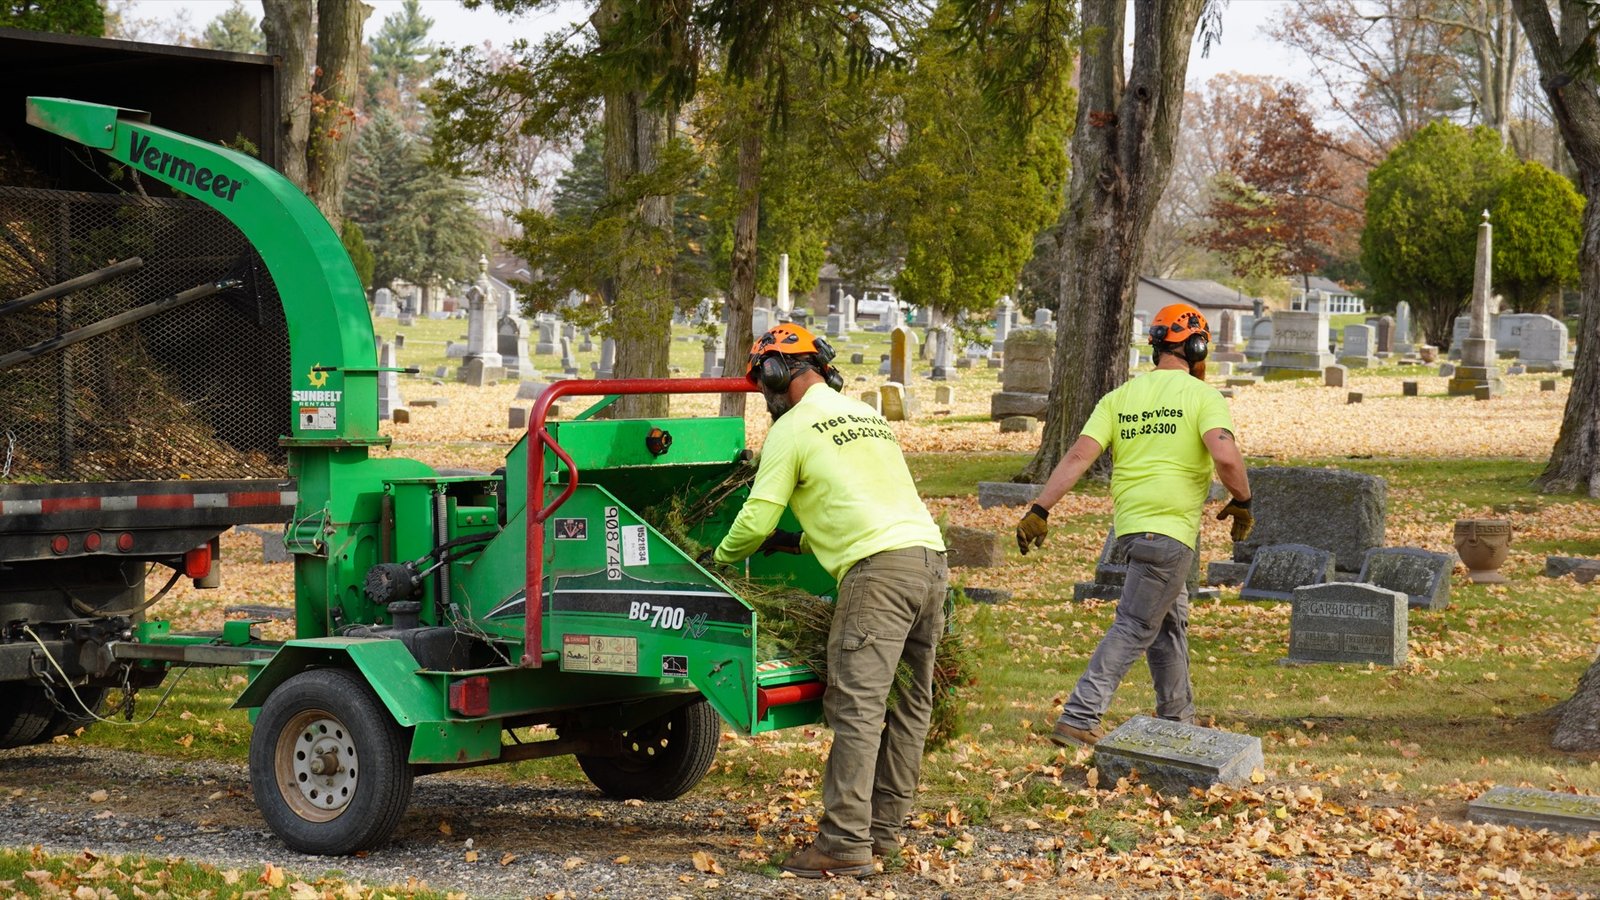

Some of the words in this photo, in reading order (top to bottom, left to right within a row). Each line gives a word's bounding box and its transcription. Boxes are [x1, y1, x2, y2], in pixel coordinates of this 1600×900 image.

[129, 130, 242, 202] Vermeer
[292, 390, 342, 402] SUNBELT
[812, 416, 847, 434] Tree
[1118, 413, 1138, 423] Tree
[605, 507, 621, 579] 908746
[628, 601, 685, 630] BC700
[1309, 602, 1376, 617] GARBRECHT
